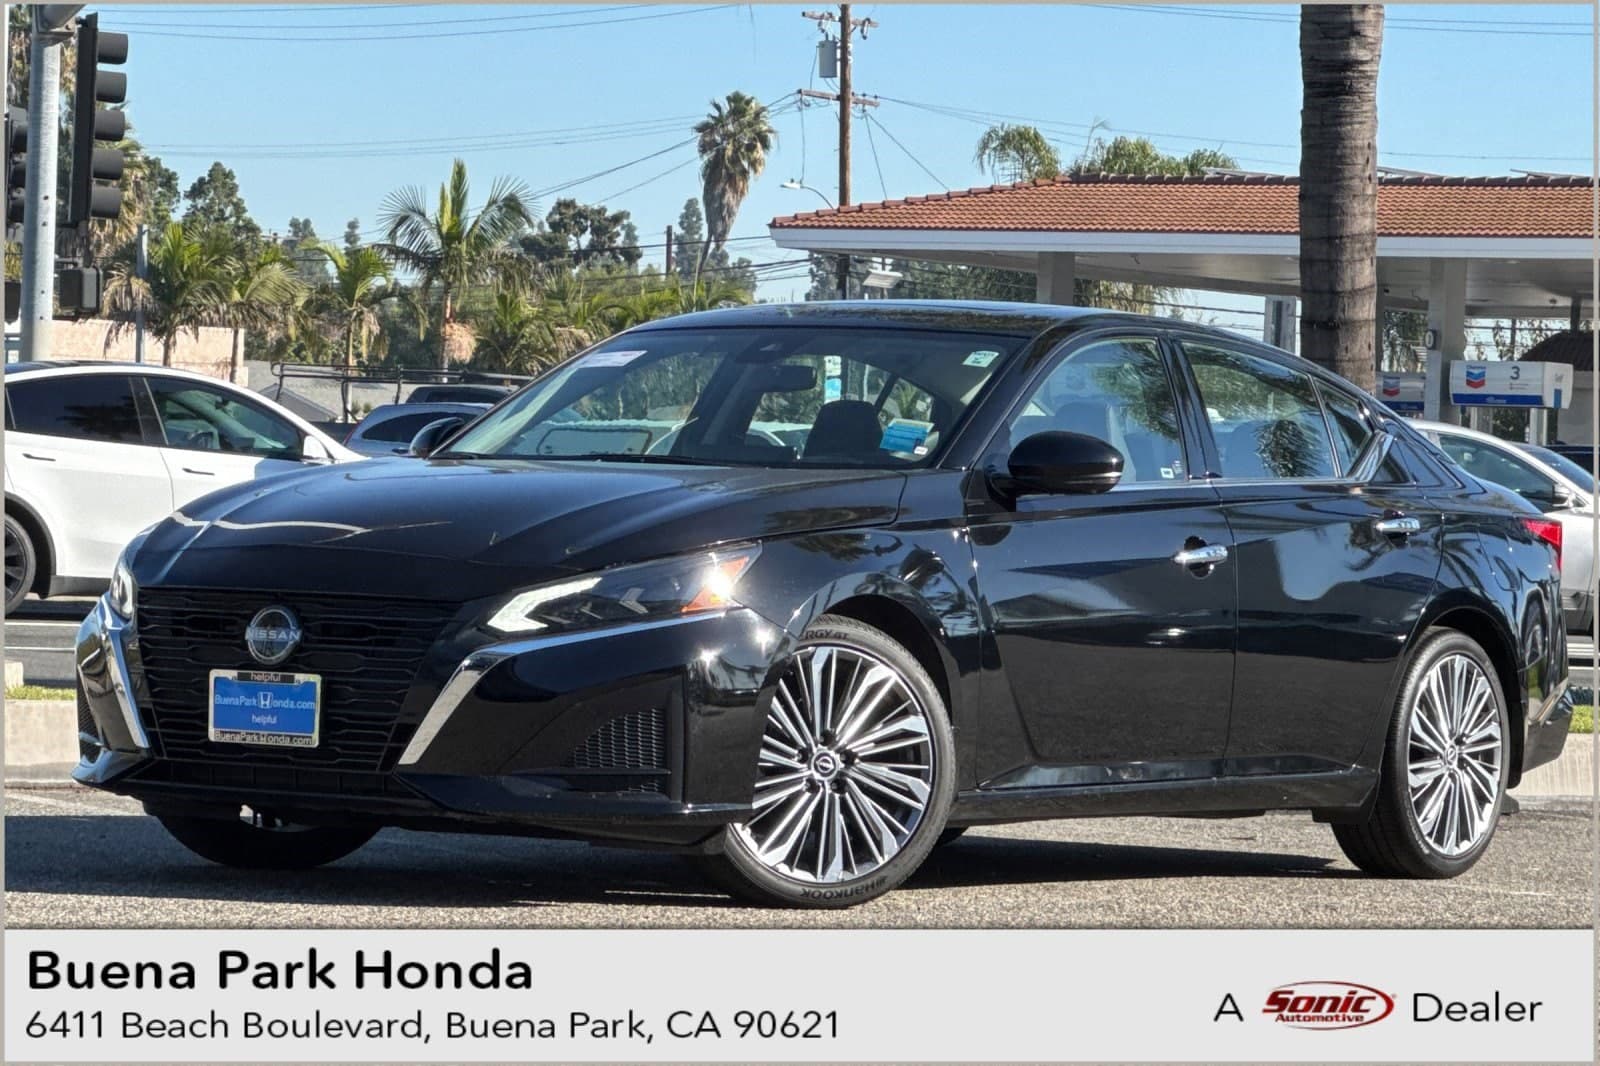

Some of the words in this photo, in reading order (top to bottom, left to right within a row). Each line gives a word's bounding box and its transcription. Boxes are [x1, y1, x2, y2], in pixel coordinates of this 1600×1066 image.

[1510, 366, 1520, 380] 3
[246, 628, 301, 641] NISSAN
[800, 629, 832, 640] RGY
[250, 671, 281, 682] helpful
[252, 714, 277, 725] helpful
